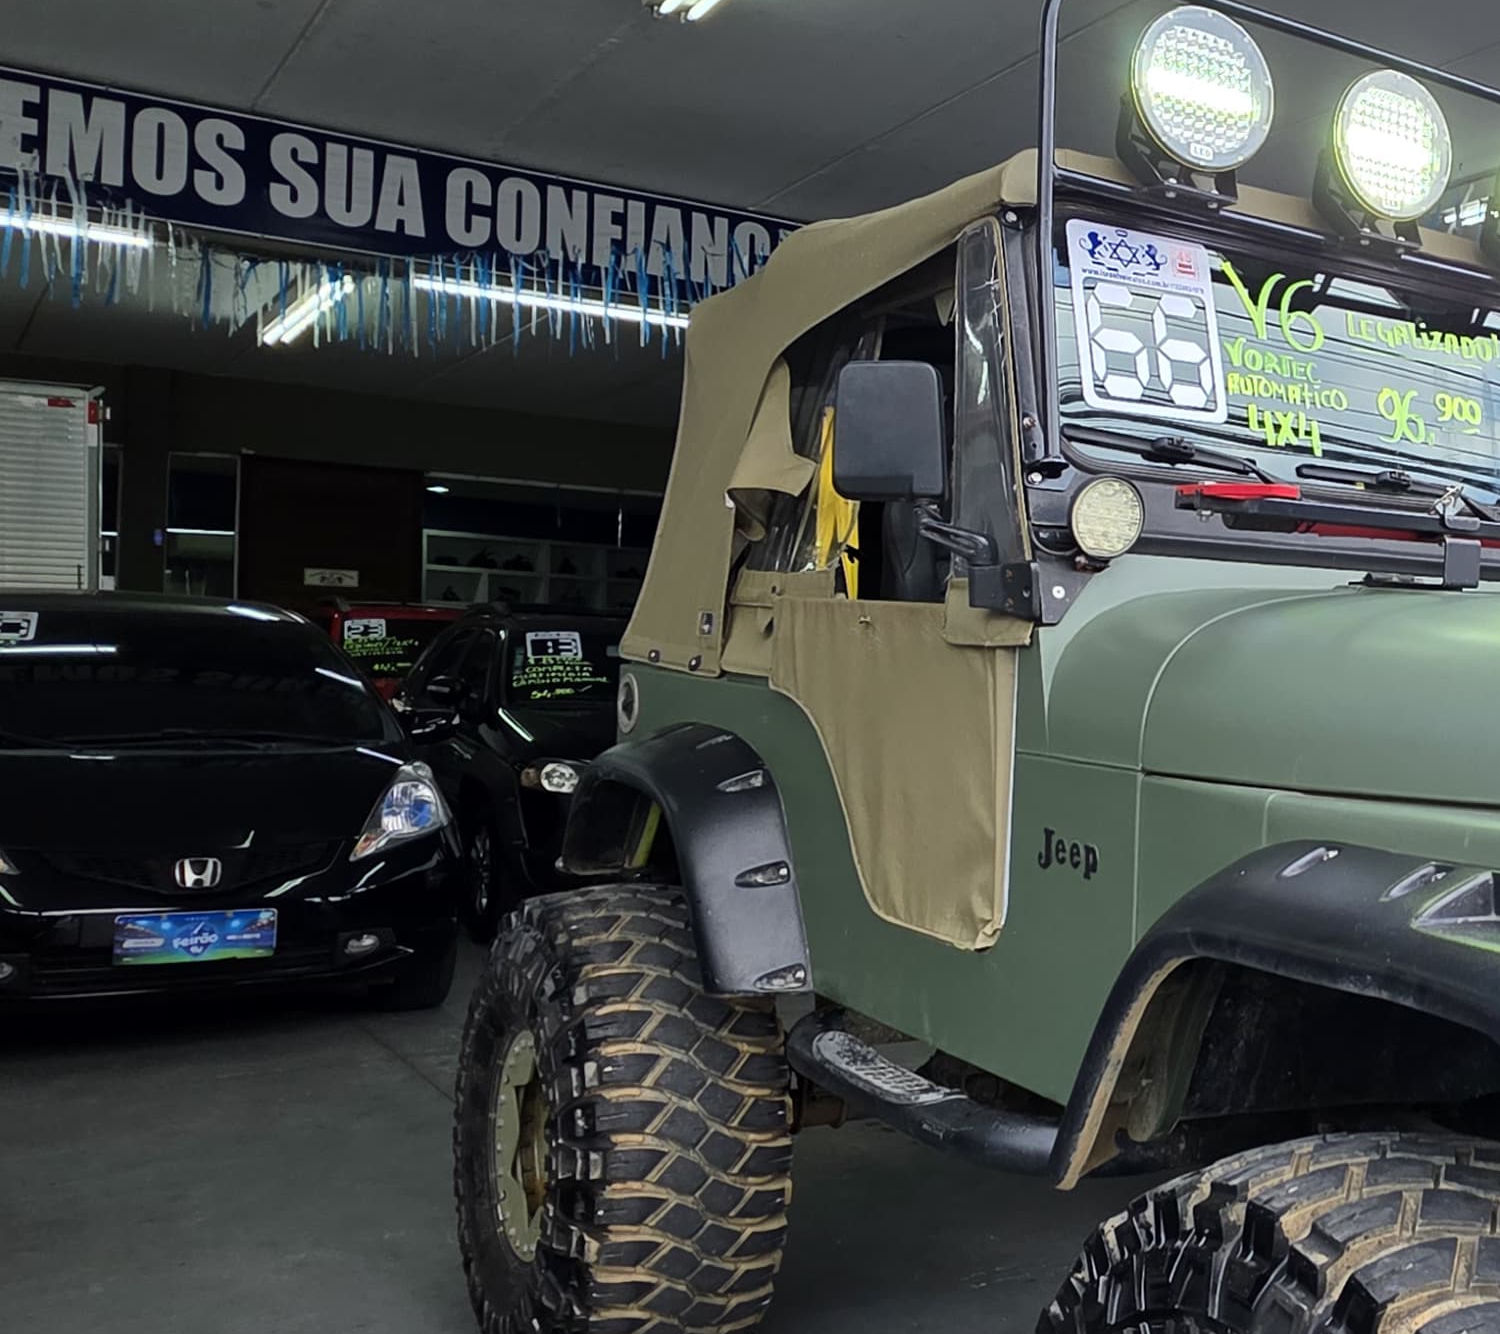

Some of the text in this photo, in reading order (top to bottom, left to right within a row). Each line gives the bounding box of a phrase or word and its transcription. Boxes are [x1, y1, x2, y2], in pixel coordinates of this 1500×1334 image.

[269, 131, 426, 239] SUA
[1221, 260, 1325, 353] V6
[1223, 336, 1322, 384] VORTEC
[1038, 827, 1099, 880] Jeep
